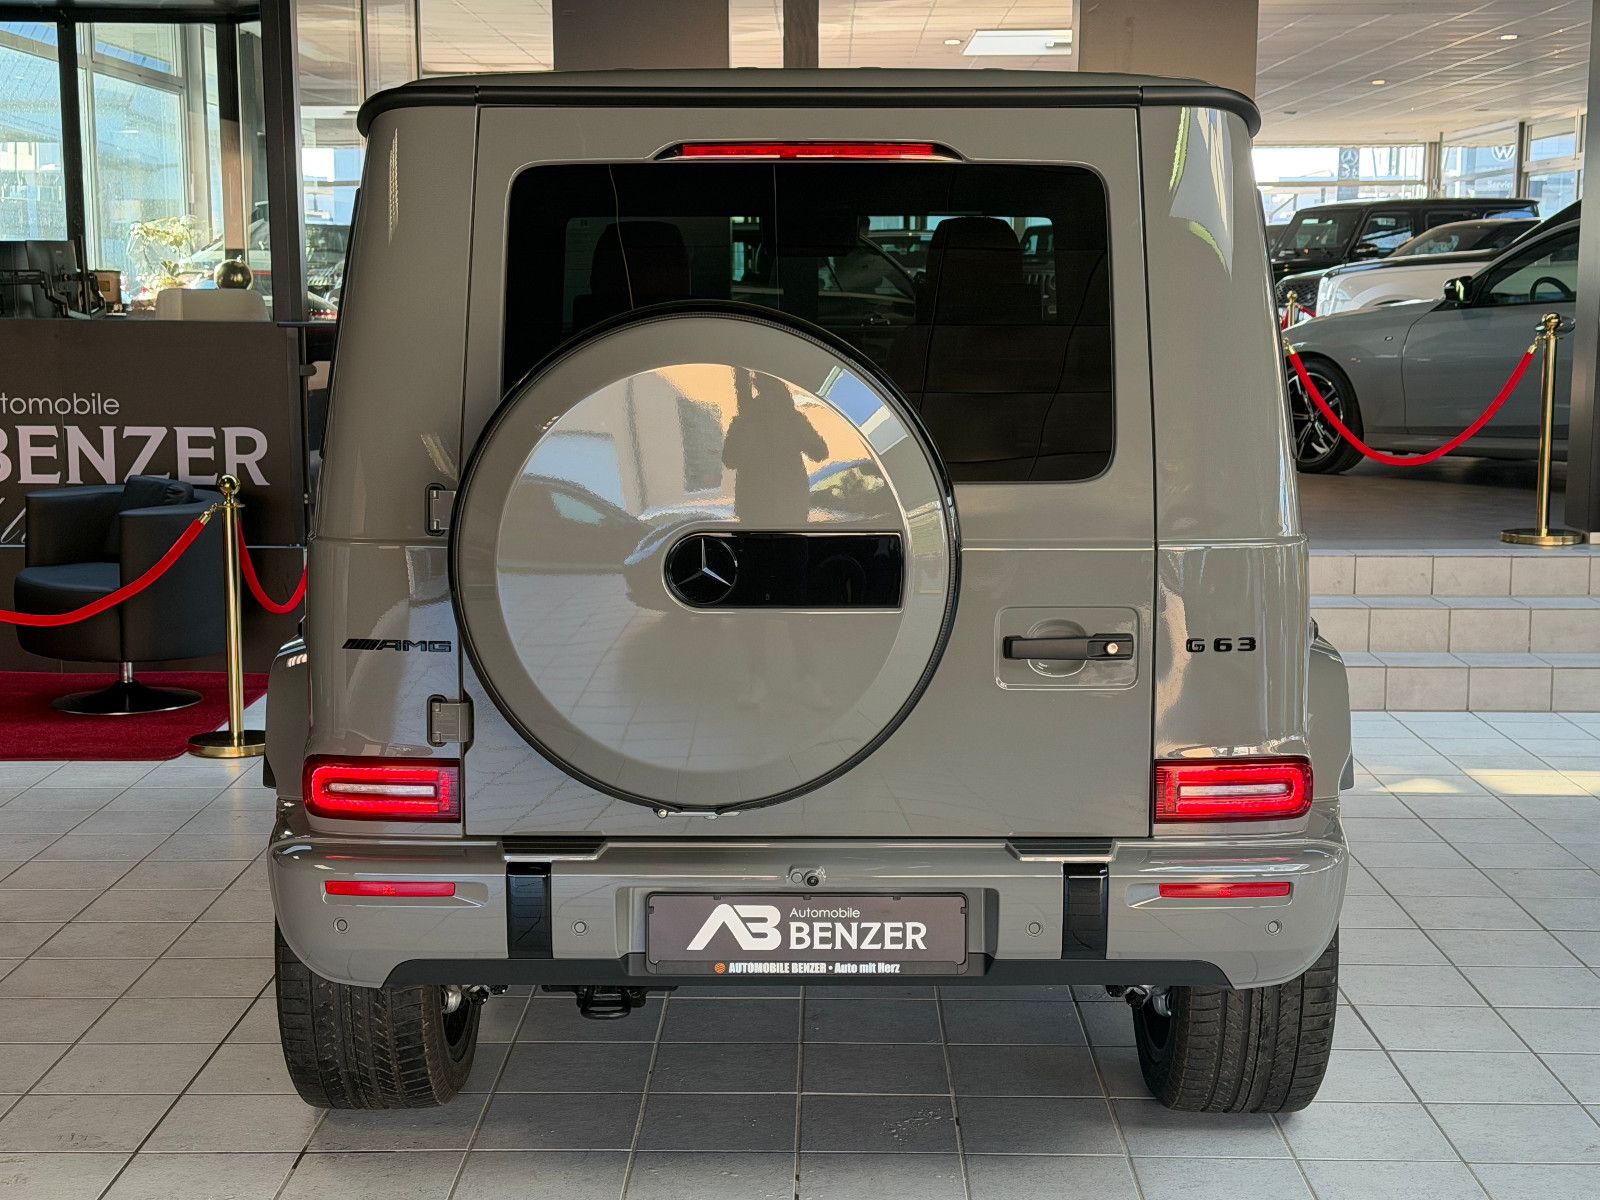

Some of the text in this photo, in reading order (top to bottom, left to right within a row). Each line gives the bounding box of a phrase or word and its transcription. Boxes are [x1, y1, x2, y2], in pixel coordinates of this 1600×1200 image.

[0, 425, 270, 486] ENZER
[1186, 637, 1257, 652] G 63
[789, 907, 861, 919] Automobile
[788, 921, 928, 950] BENZER
[728, 962, 901, 974] AUTOMOBILE BENZER Auto mit Herz
